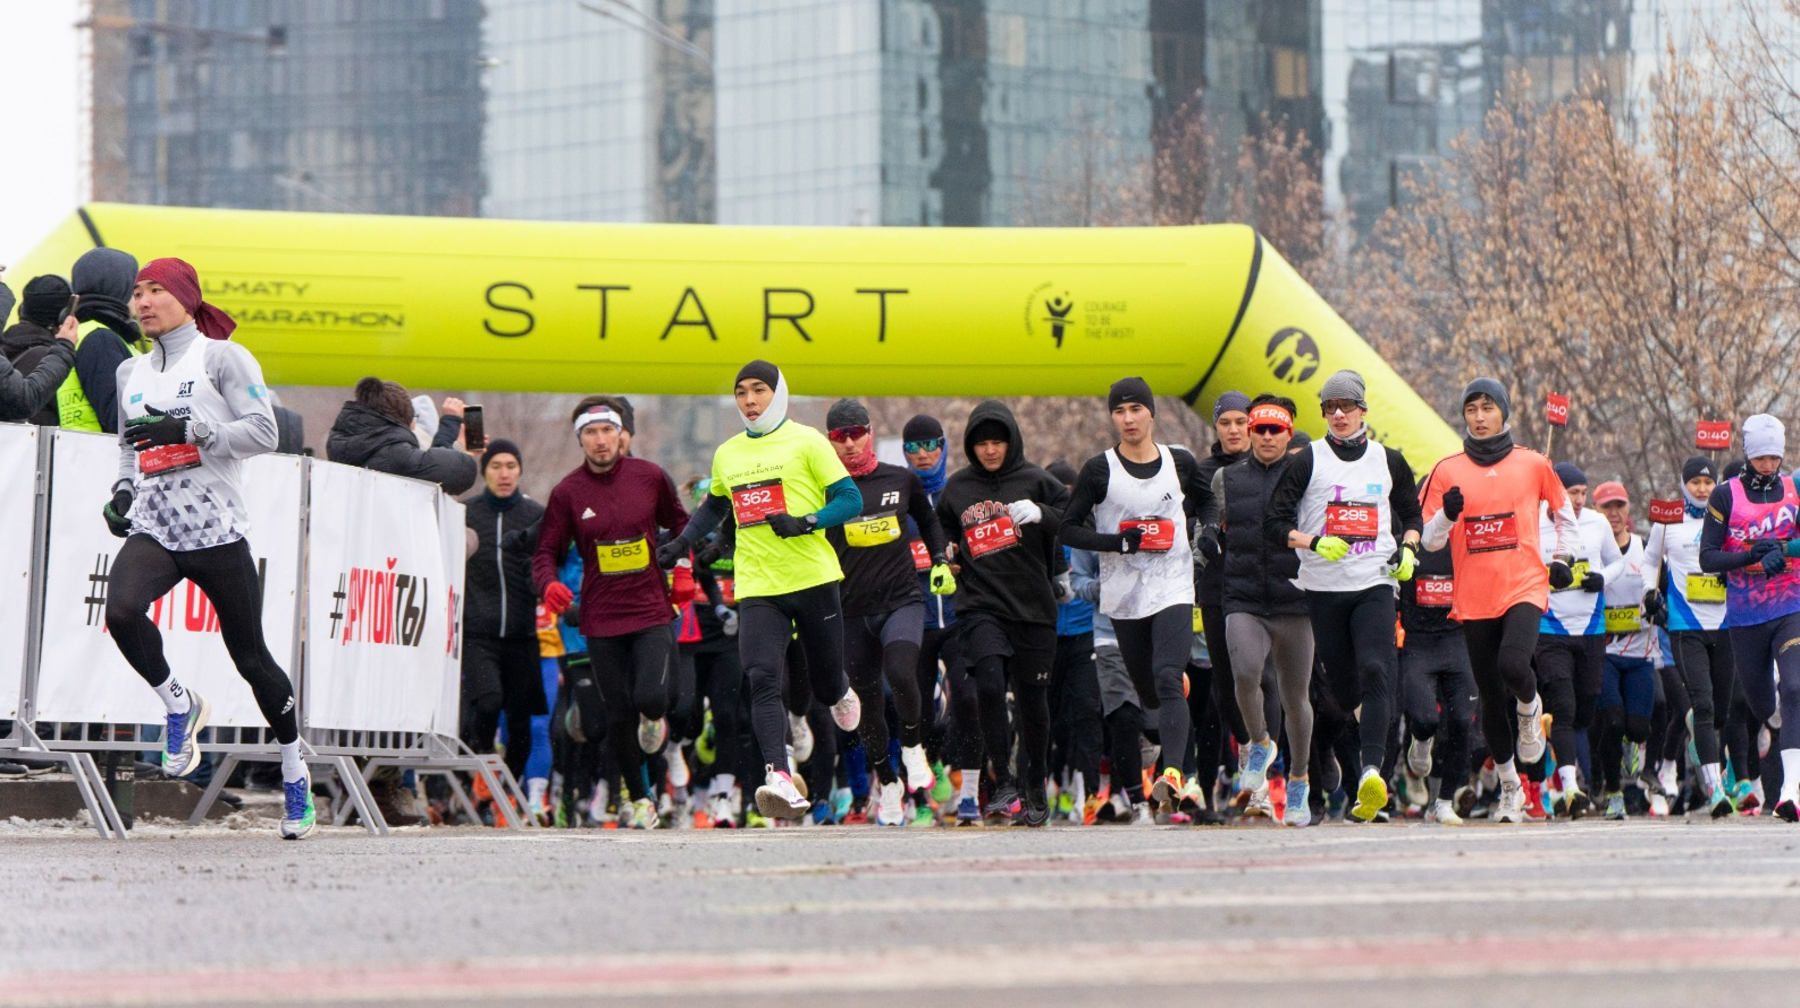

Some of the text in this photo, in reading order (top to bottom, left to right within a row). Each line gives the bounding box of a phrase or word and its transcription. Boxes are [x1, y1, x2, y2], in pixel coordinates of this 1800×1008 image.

[201, 280, 310, 296] LMATY
[225, 309, 405, 327] MARATHON
[483, 282, 909, 343] START
[1697, 430, 1730, 440] 0:40
[740, 490, 772, 506] 362
[1338, 509, 1368, 521] 295
[1651, 505, 1683, 516] 0:40
[860, 521, 890, 534] 752
[974, 522, 1000, 539] 671
[1474, 521, 1504, 535] 247
[611, 545, 642, 558] 863
[1425, 582, 1453, 592] 528
[1700, 578, 1722, 588] 713
[1609, 611, 1634, 620] 802
